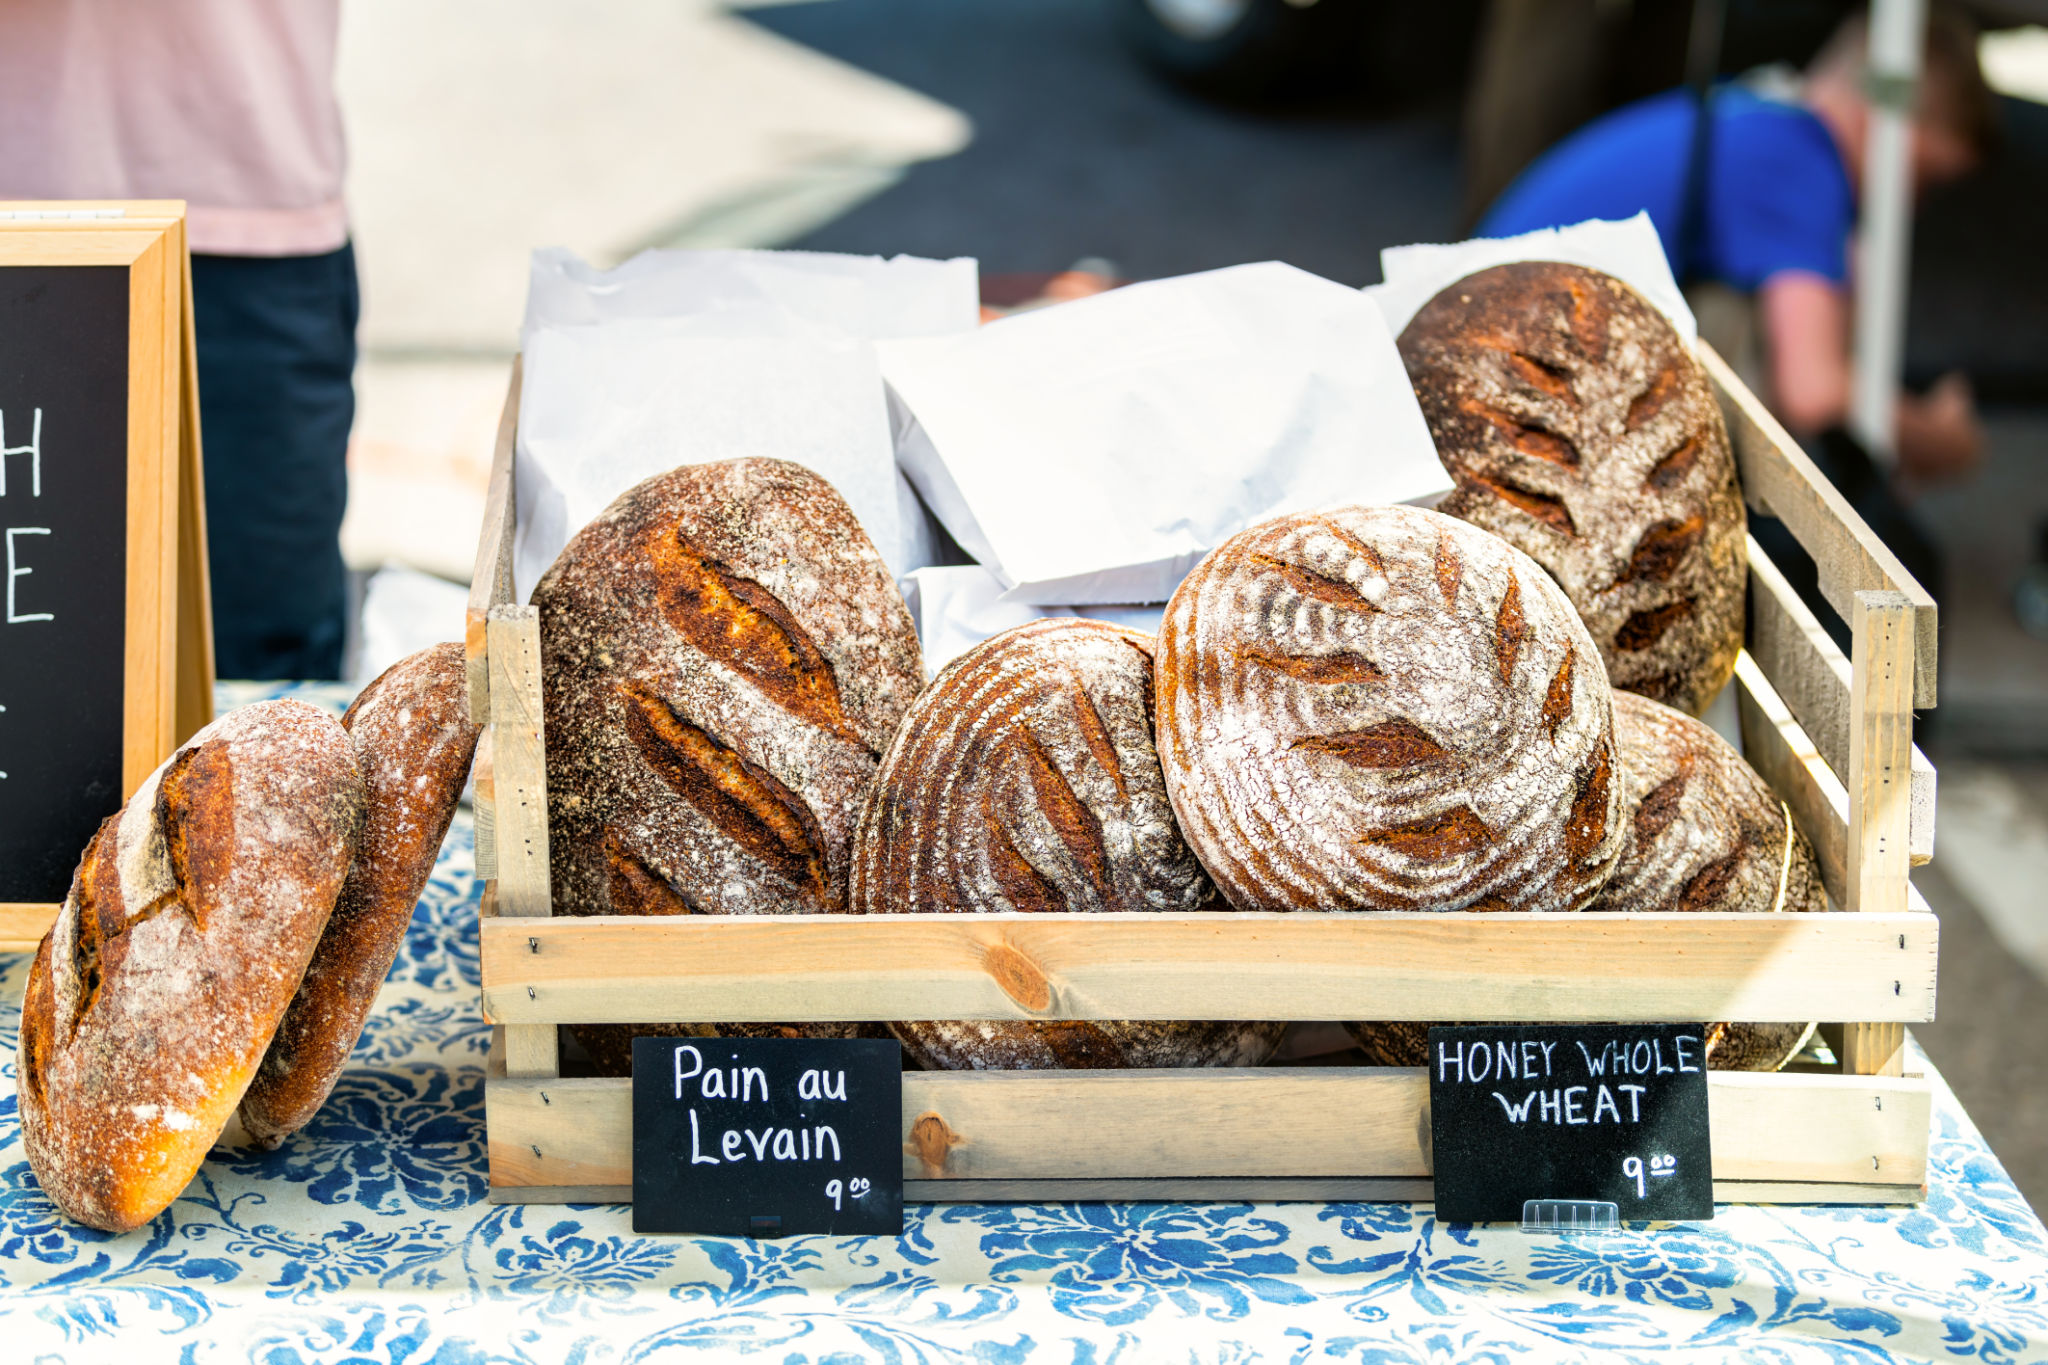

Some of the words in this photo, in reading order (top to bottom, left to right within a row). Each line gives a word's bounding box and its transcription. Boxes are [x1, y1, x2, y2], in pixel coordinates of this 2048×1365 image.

[0, 408, 43, 497] H
[5, 526, 54, 623] E
[674, 1045, 769, 1102] Pain
[798, 1069, 847, 1101] au
[1438, 1040, 1557, 1083] HONEY
[1576, 1035, 1700, 1077] WHOLE
[1491, 1084, 1646, 1124] WHEAT
[689, 1108, 841, 1165] Levain
